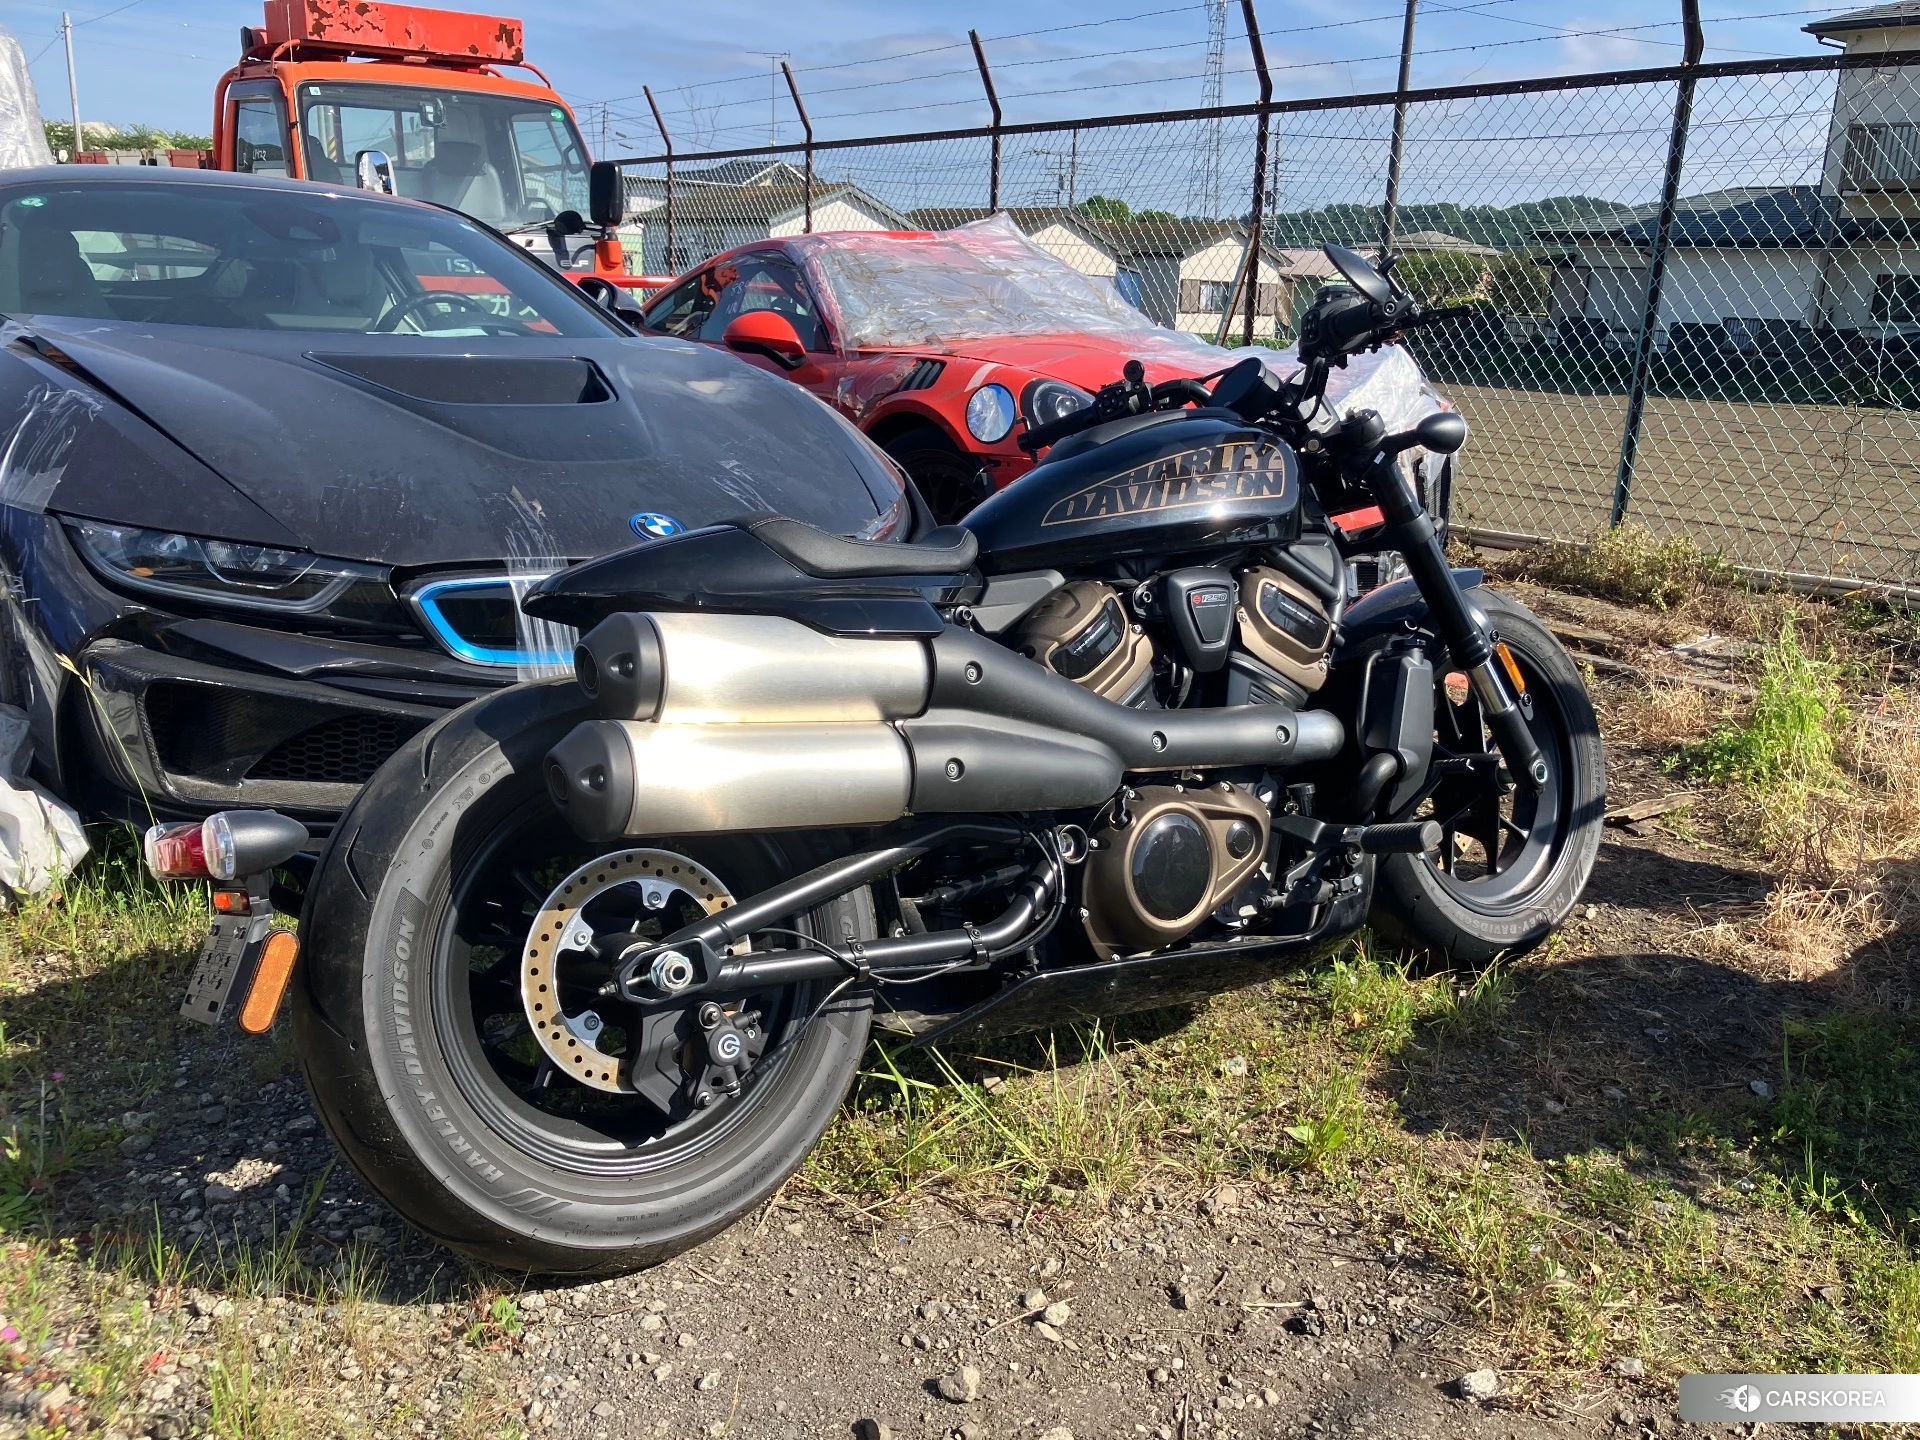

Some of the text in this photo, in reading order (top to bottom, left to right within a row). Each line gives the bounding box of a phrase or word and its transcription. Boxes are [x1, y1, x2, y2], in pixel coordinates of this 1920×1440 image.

[560, 259, 589, 268] ELF
[1055, 470, 1284, 522] DAVIDSON
[392, 915, 505, 1184] HARLEY-DAVIDSON
